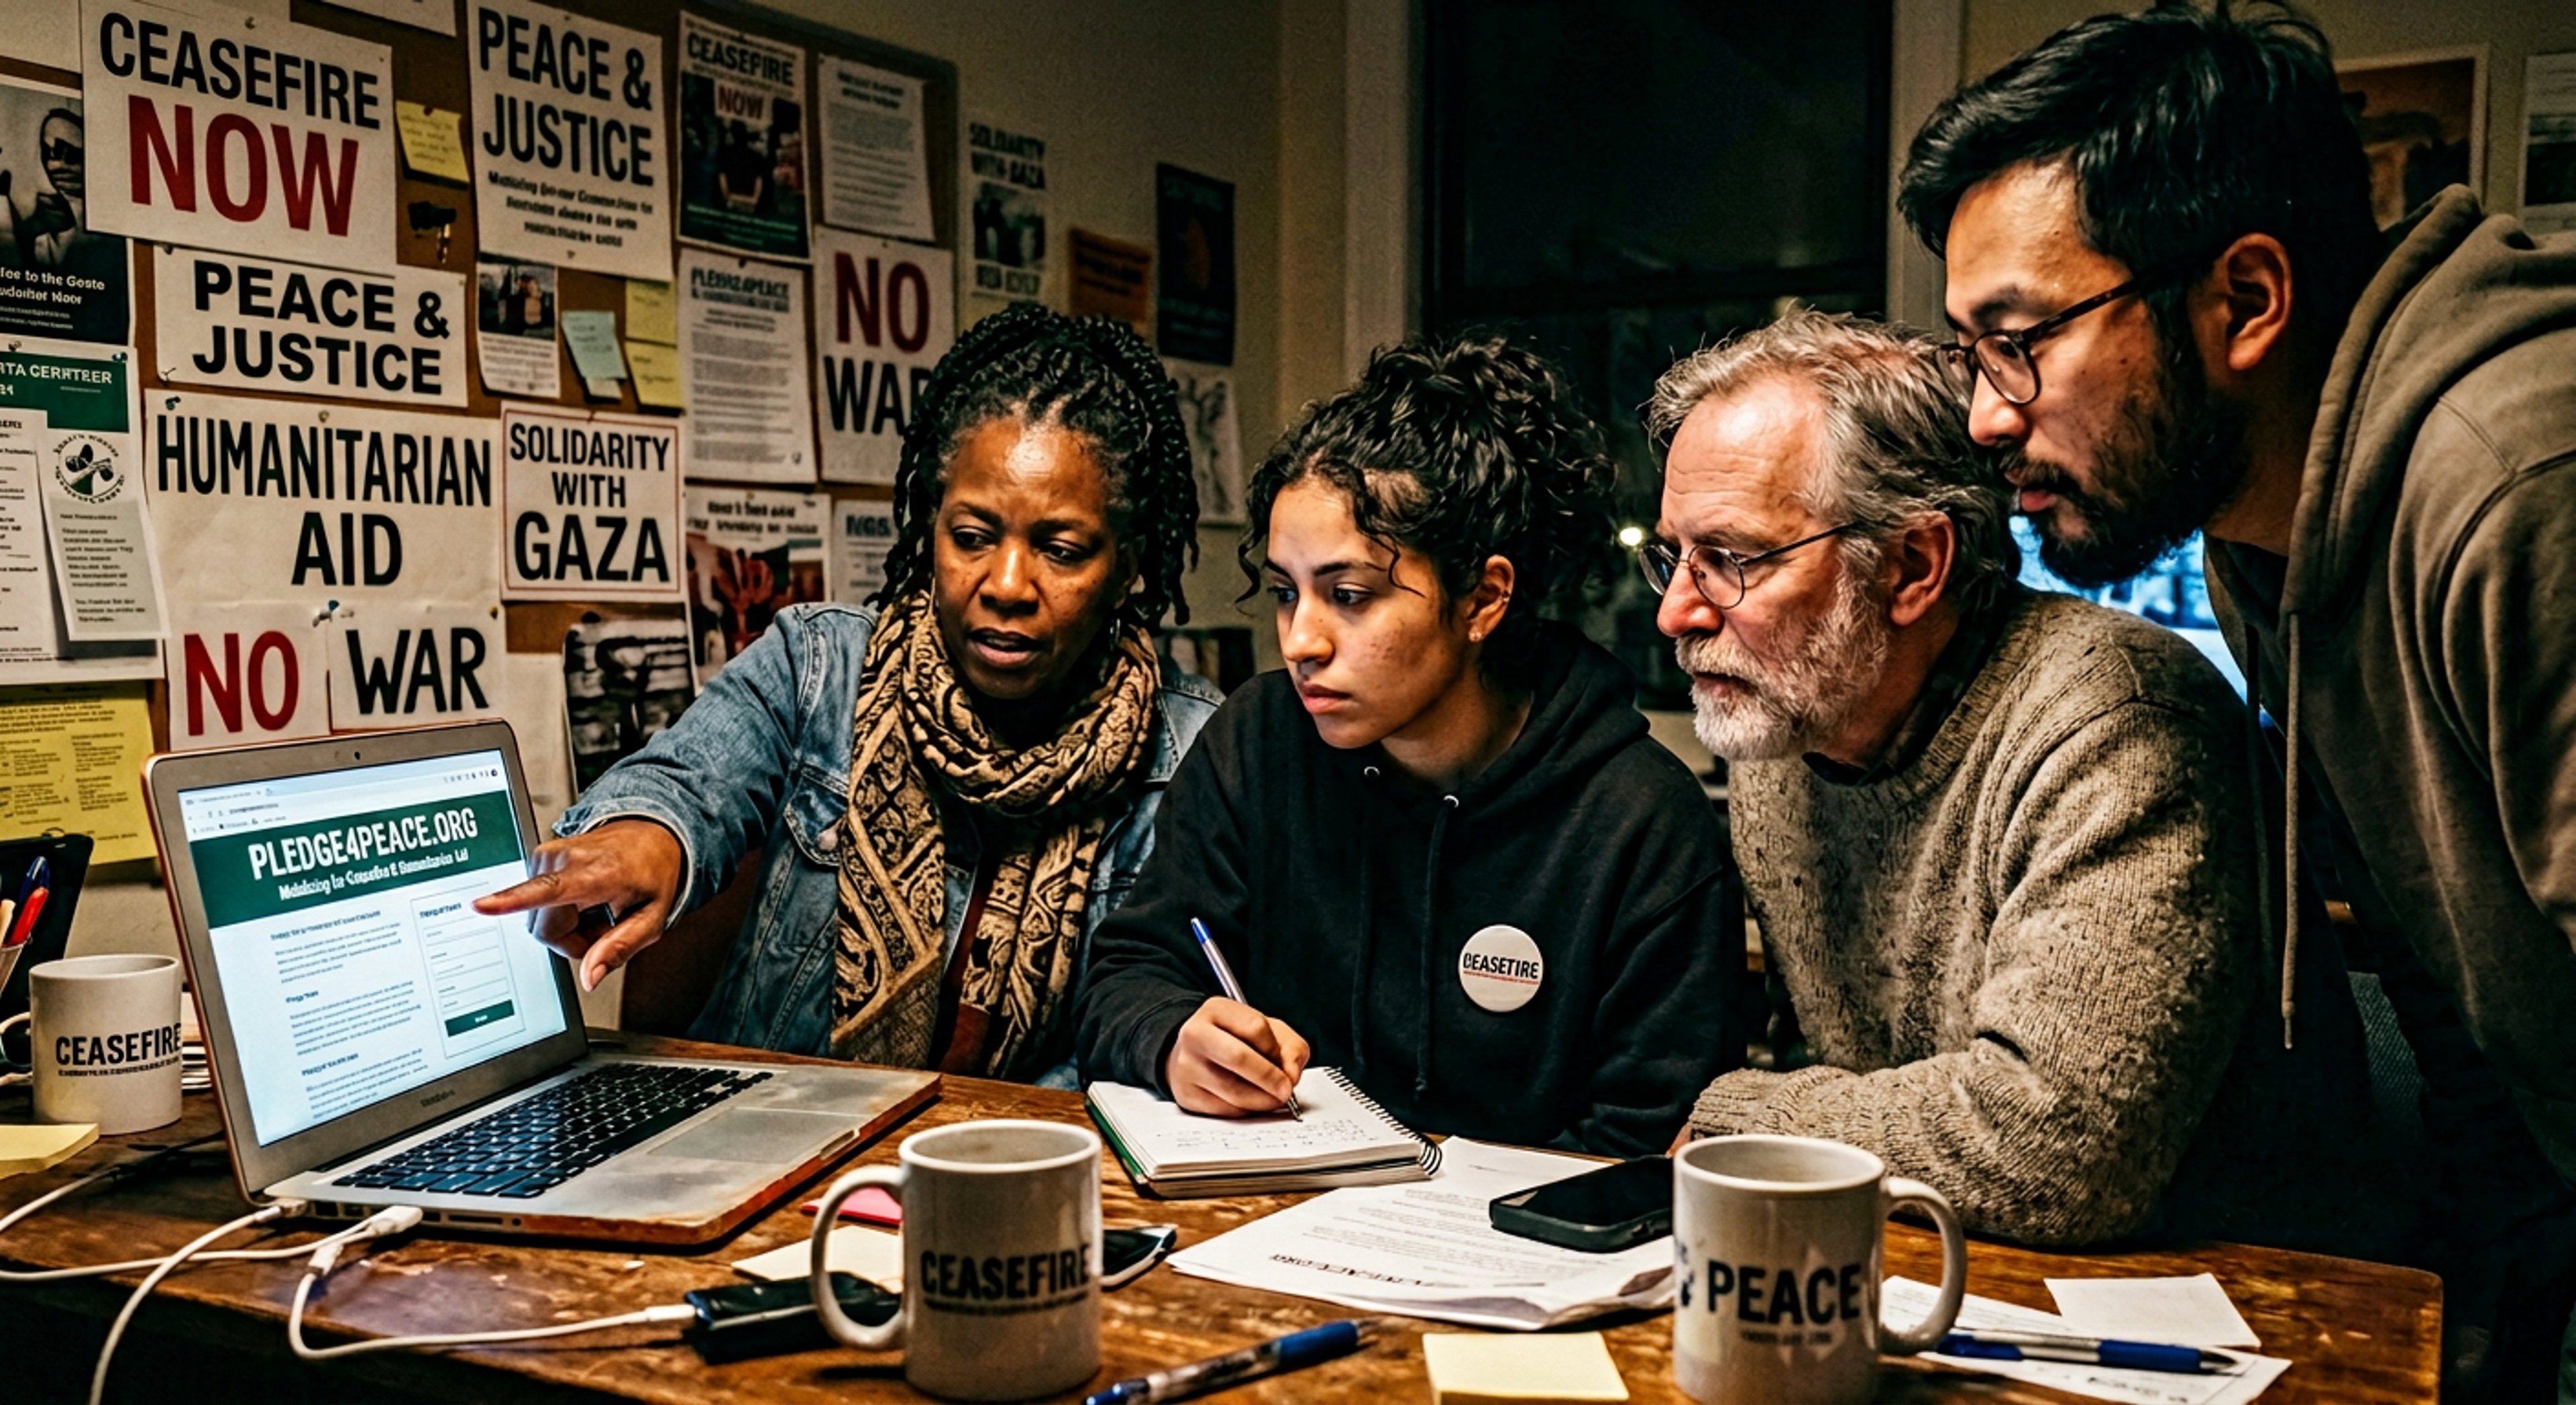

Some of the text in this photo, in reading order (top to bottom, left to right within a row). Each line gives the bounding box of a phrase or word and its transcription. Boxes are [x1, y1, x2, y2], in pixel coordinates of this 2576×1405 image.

[99, 12, 380, 130] CEASEFIRE
[478, 7, 611, 101] PEACE
[623, 48, 652, 111] &
[128, 95, 358, 237] NOW
[482, 93, 653, 187] JUSTICE
[194, 260, 449, 339] PEACE &
[835, 250, 930, 354] NO
[193, 325, 442, 395] JUSTICE
[157, 414, 490, 507] HUMANITARIAN
[510, 423, 669, 471] SOLIDARITY
[551, 471, 626, 508] WITH
[291, 512, 402, 586] AID
[515, 511, 669, 582] GAZA
[184, 628, 489, 736] NO WAR
[248, 807, 478, 880] PLEDGE4PEACE.ORG
[56, 1023, 181, 1065] CEASEFIRE
[920, 1243, 1090, 1300] CEASEFIRE
[1708, 1258, 1861, 1326] PEACE
